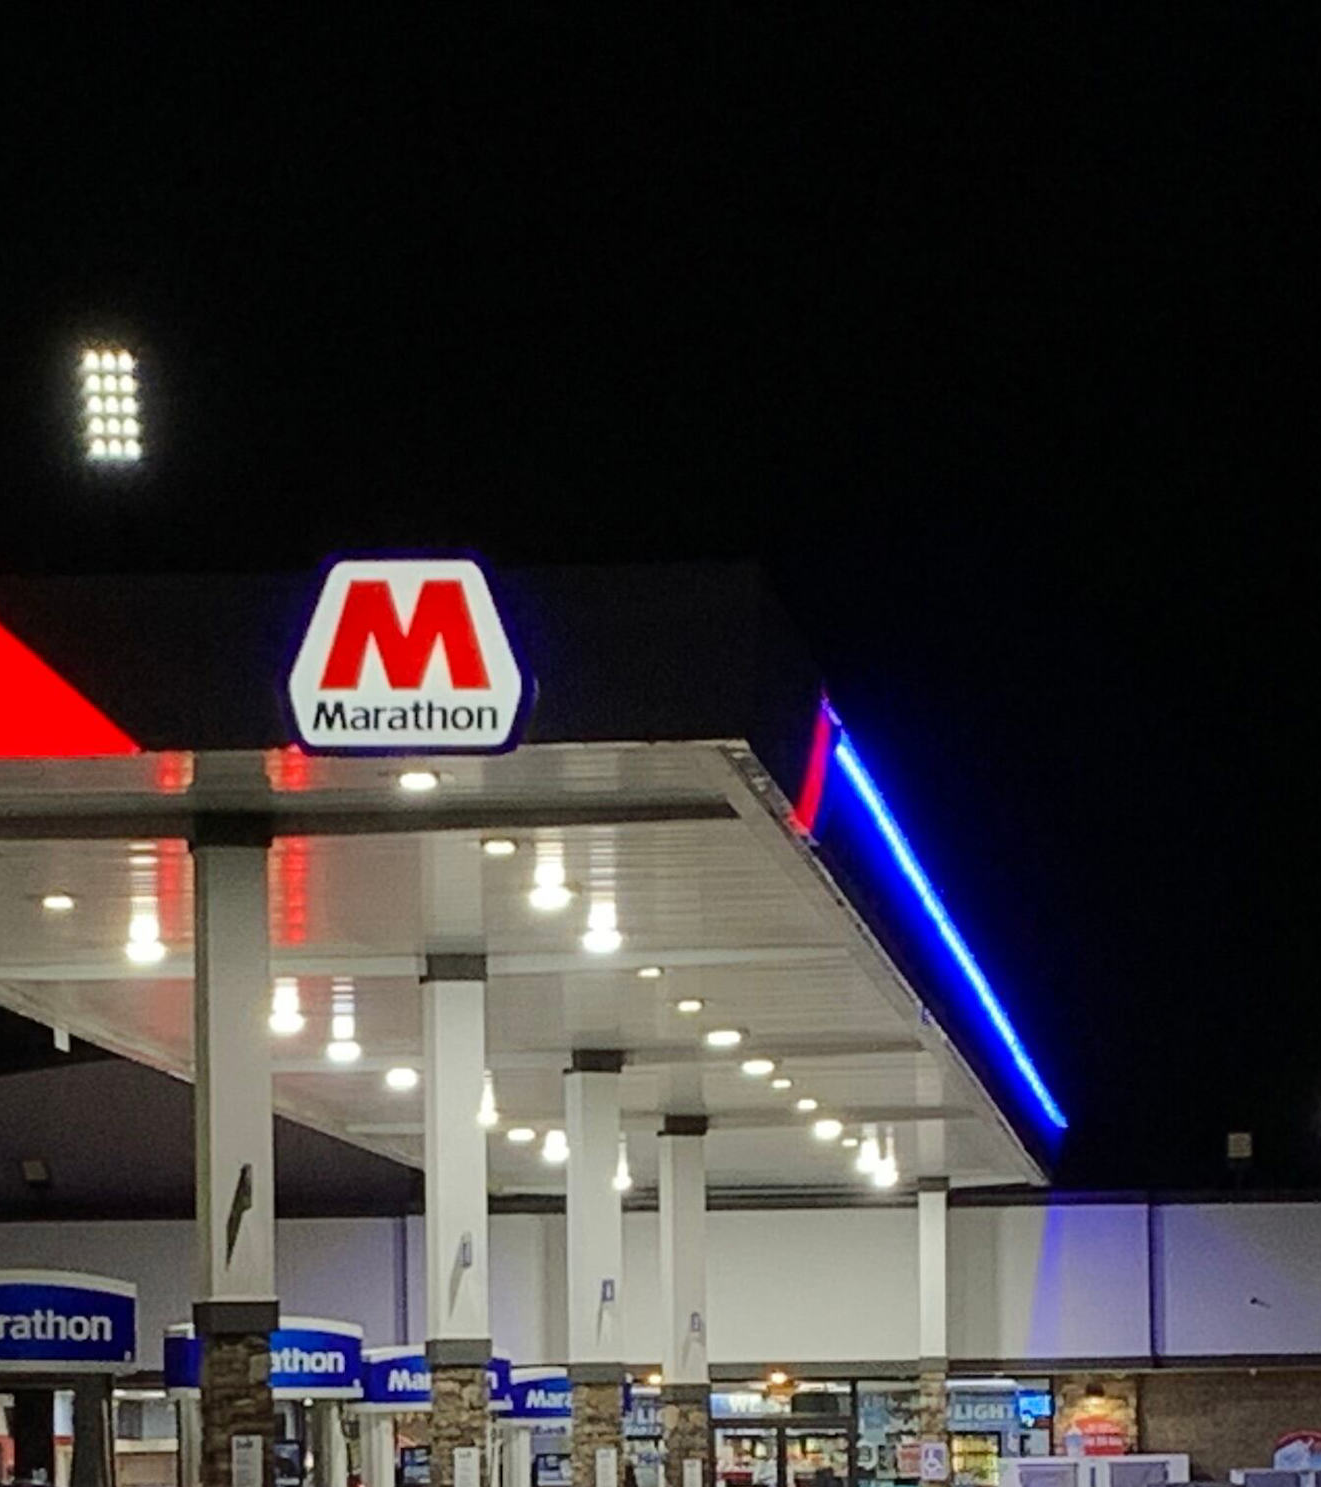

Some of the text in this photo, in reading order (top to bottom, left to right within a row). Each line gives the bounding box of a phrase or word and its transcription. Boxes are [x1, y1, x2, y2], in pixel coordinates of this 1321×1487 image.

[319, 579, 492, 690] M
[313, 700, 498, 731] Marathon
[270, 1346, 346, 1374] athon
